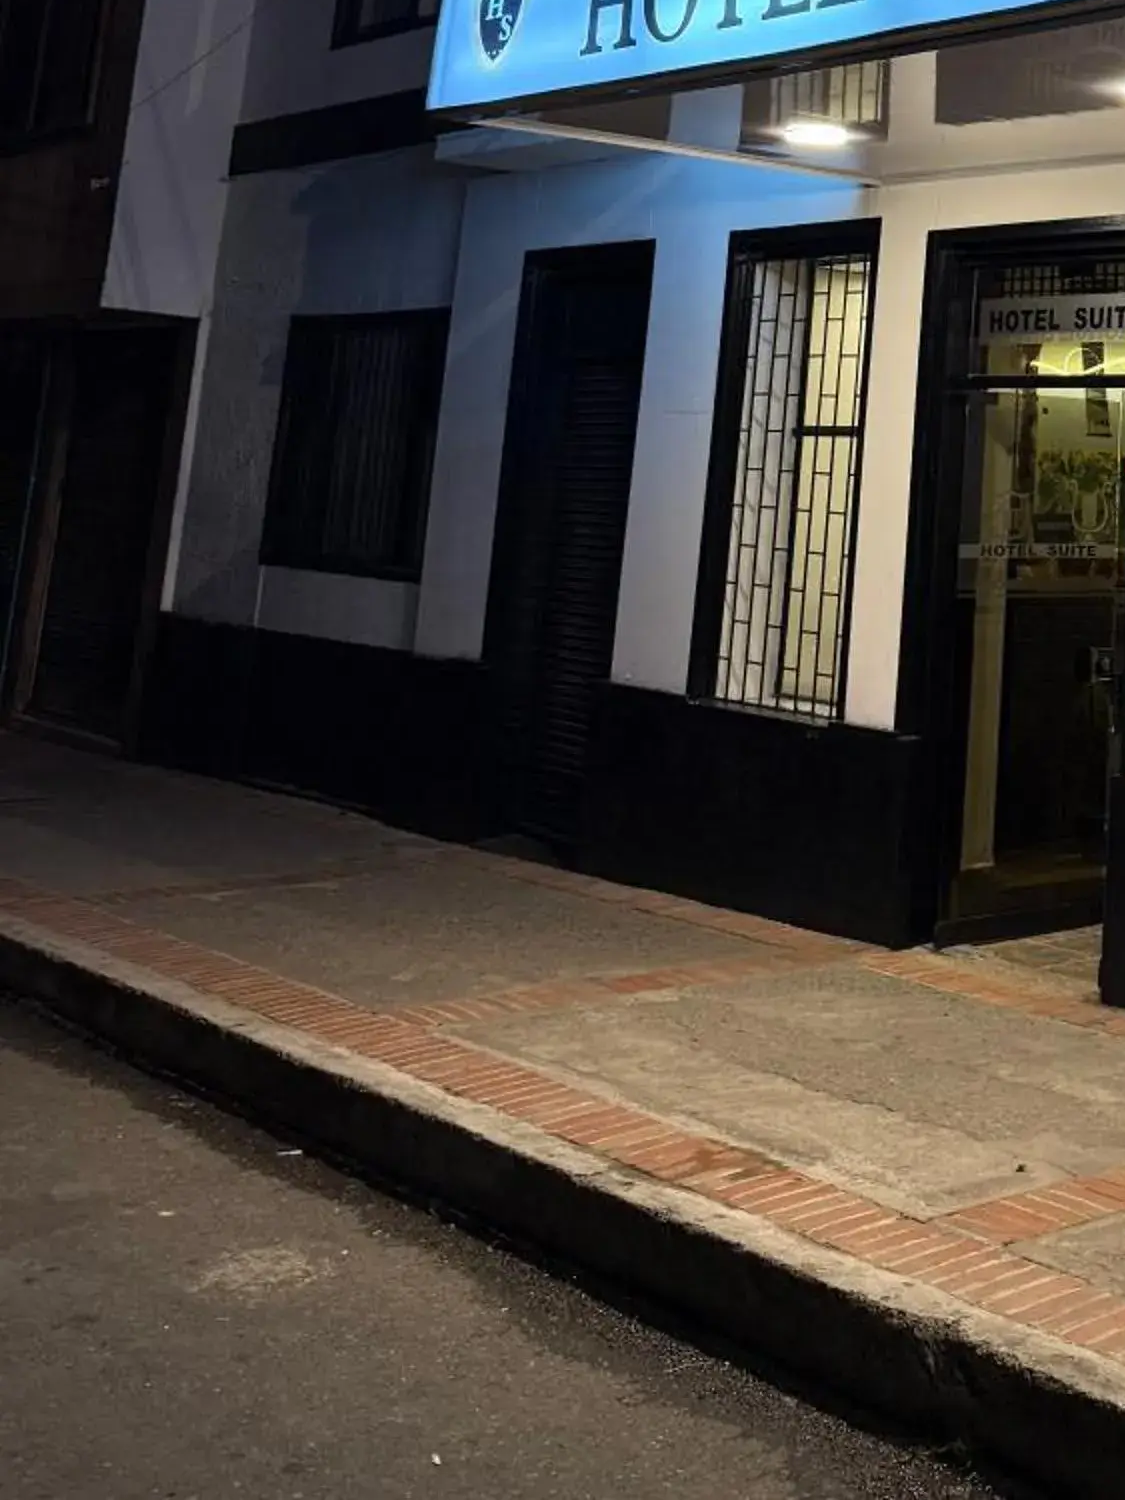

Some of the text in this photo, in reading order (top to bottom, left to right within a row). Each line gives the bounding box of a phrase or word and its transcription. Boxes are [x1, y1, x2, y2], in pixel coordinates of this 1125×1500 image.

[989, 307, 1061, 333] HOTEL
[980, 543, 1097, 558] HOTEL SUITE
